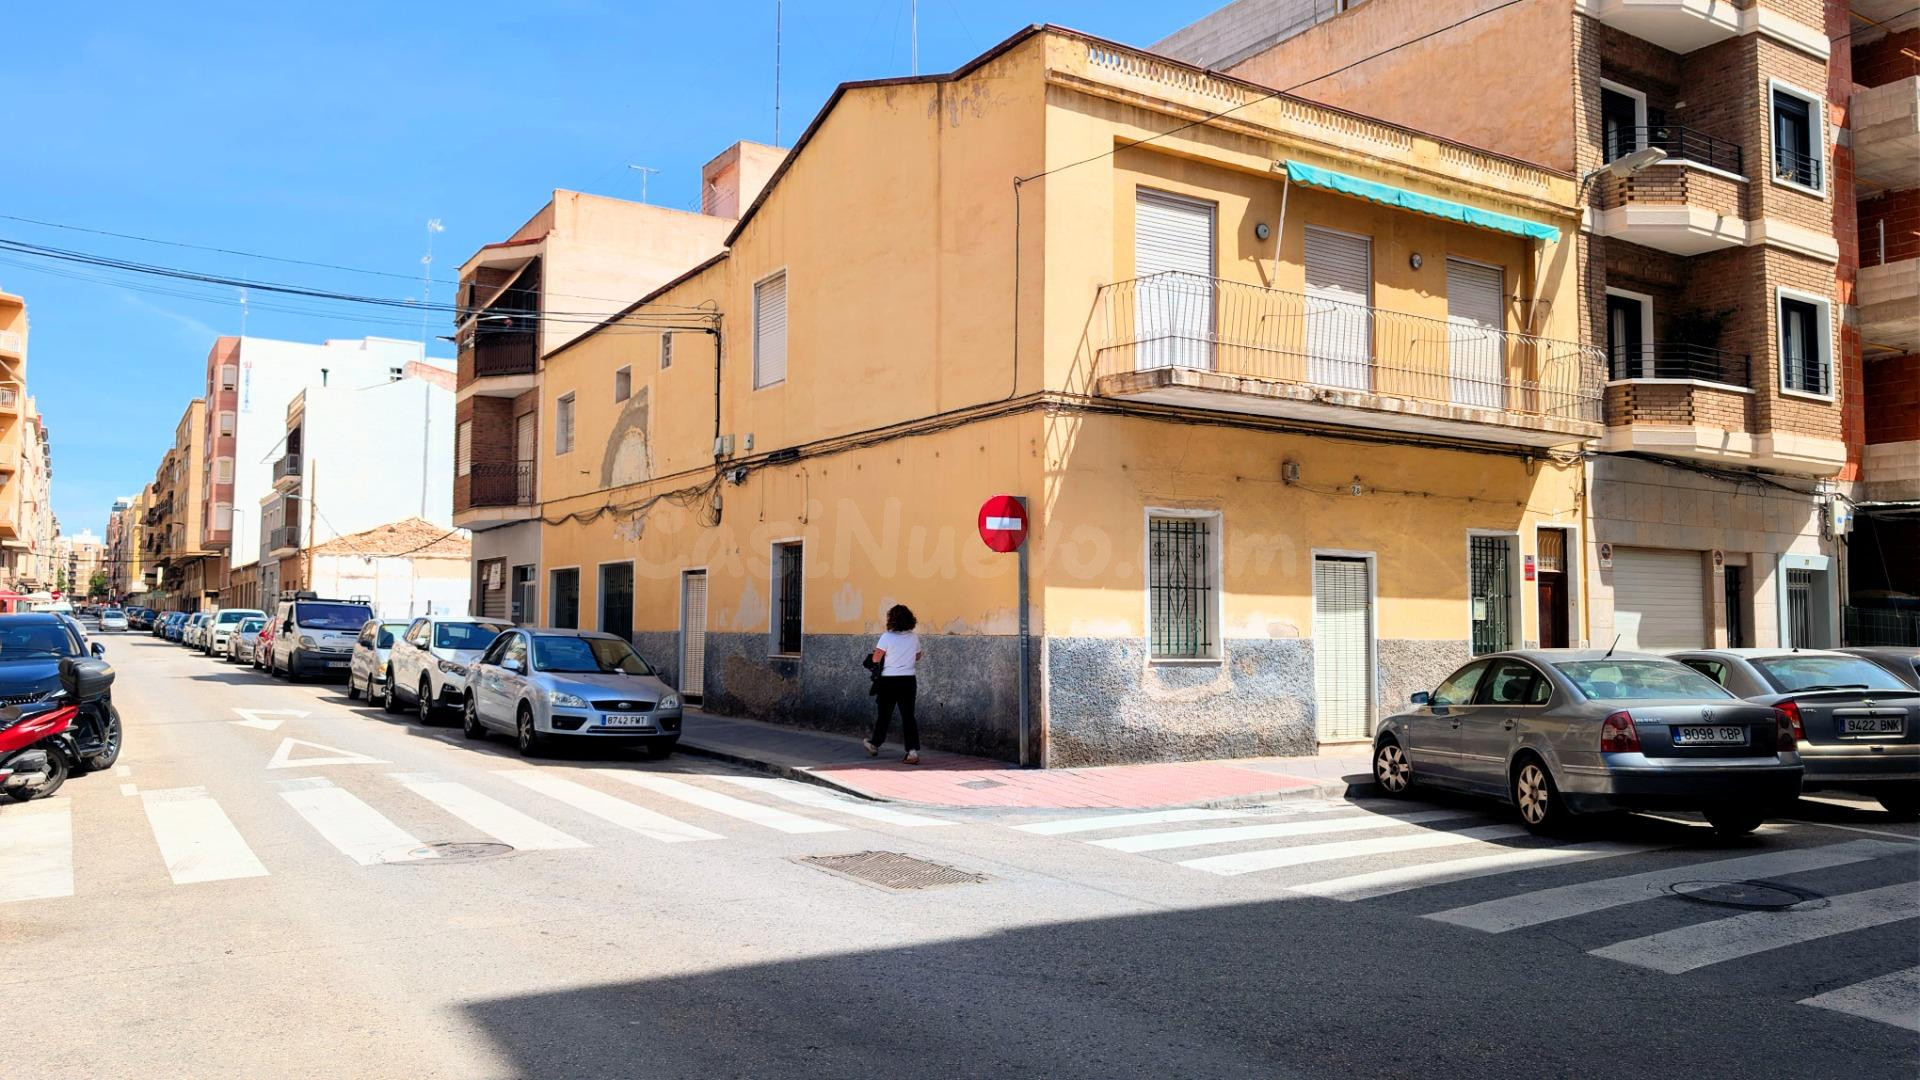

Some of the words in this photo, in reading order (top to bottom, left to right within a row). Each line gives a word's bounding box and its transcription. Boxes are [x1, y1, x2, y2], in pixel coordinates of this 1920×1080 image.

[607, 716, 629, 725] 8742
[1848, 720, 1876, 731] 9422
[1880, 720, 1900, 731] BNK
[1683, 728, 1715, 740] 8098
[1719, 728, 1741, 740] CBP
